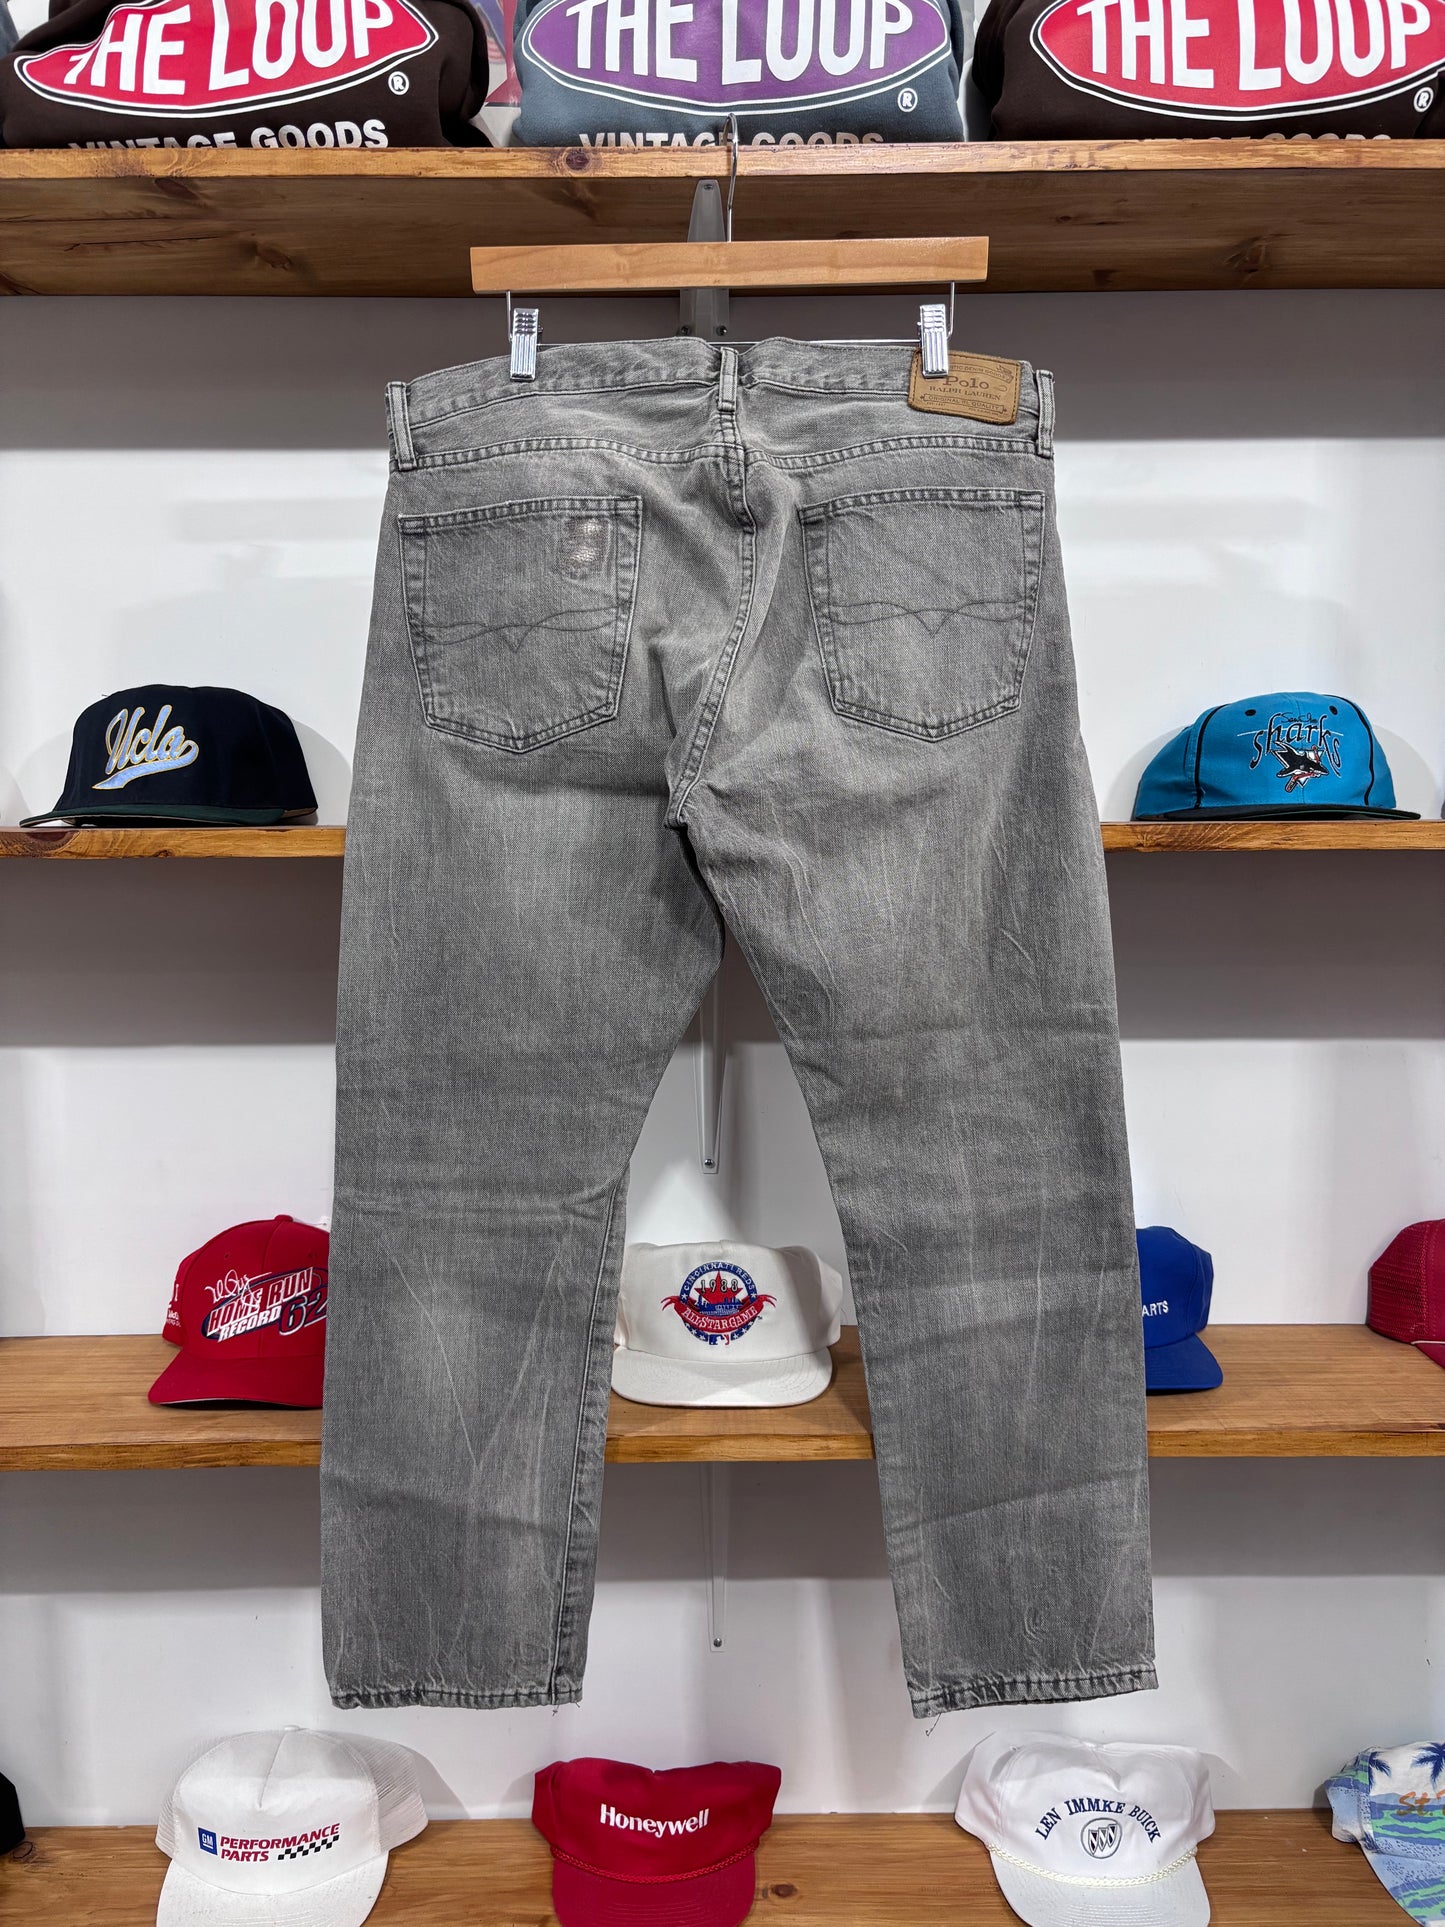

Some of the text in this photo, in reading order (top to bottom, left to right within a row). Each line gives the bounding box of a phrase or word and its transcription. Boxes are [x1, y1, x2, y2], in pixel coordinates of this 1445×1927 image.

[64, 0, 394, 95] THE LOUP
[565, 0, 914, 85] THE LOUP
[1076, 0, 1431, 90] THE LOUP
[251, 119, 389, 149] GOODS
[929, 386, 1002, 401] RALPH LAUREN
[943, 375, 989, 390] Polo
[971, 401, 1000, 411] QUALITY
[684, 1262, 755, 1291] CINCINNATI REDS
[207, 1288, 264, 1336] HOME
[267, 1267, 313, 1309] RUN
[279, 1287, 328, 1336] 62
[1142, 1300, 1169, 1317] ARTS
[218, 1305, 282, 1343] RECORD
[729, 1306, 757, 1328] GAME
[600, 1803, 709, 1838] Honeywell
[1035, 1797, 1161, 1844] LEN IMMKE BUICK
[202, 1833, 213, 1846] GM
[220, 1823, 340, 1850] PERFORMANCE
[220, 1850, 269, 1862] PARTS
